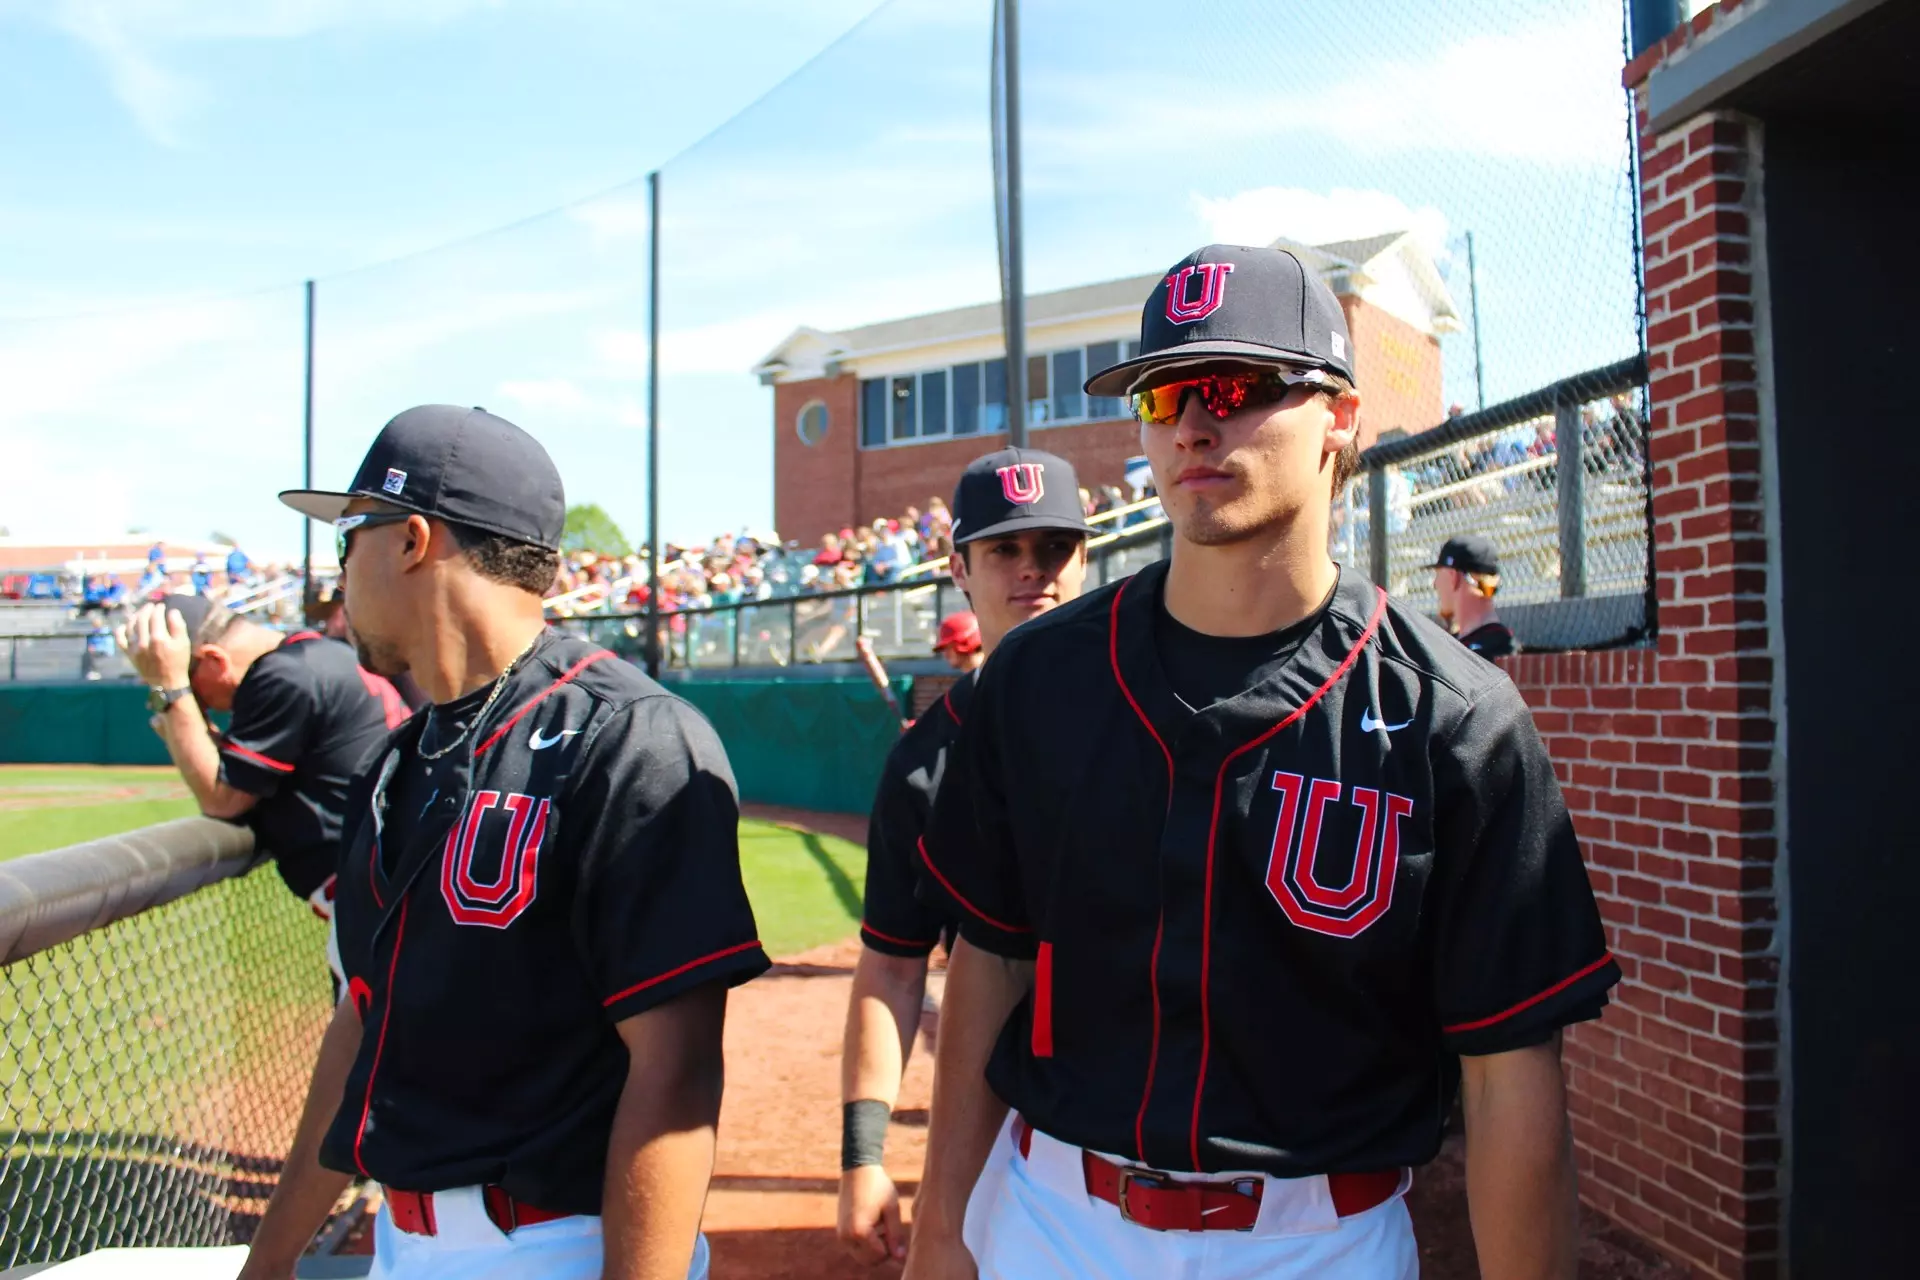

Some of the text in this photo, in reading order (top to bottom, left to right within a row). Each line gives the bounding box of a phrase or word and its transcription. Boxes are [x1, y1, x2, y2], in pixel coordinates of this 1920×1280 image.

[1165, 263, 1235, 326] U
[996, 463, 1044, 505] U
[440, 790, 551, 930] U
[1265, 770, 1414, 939] U
